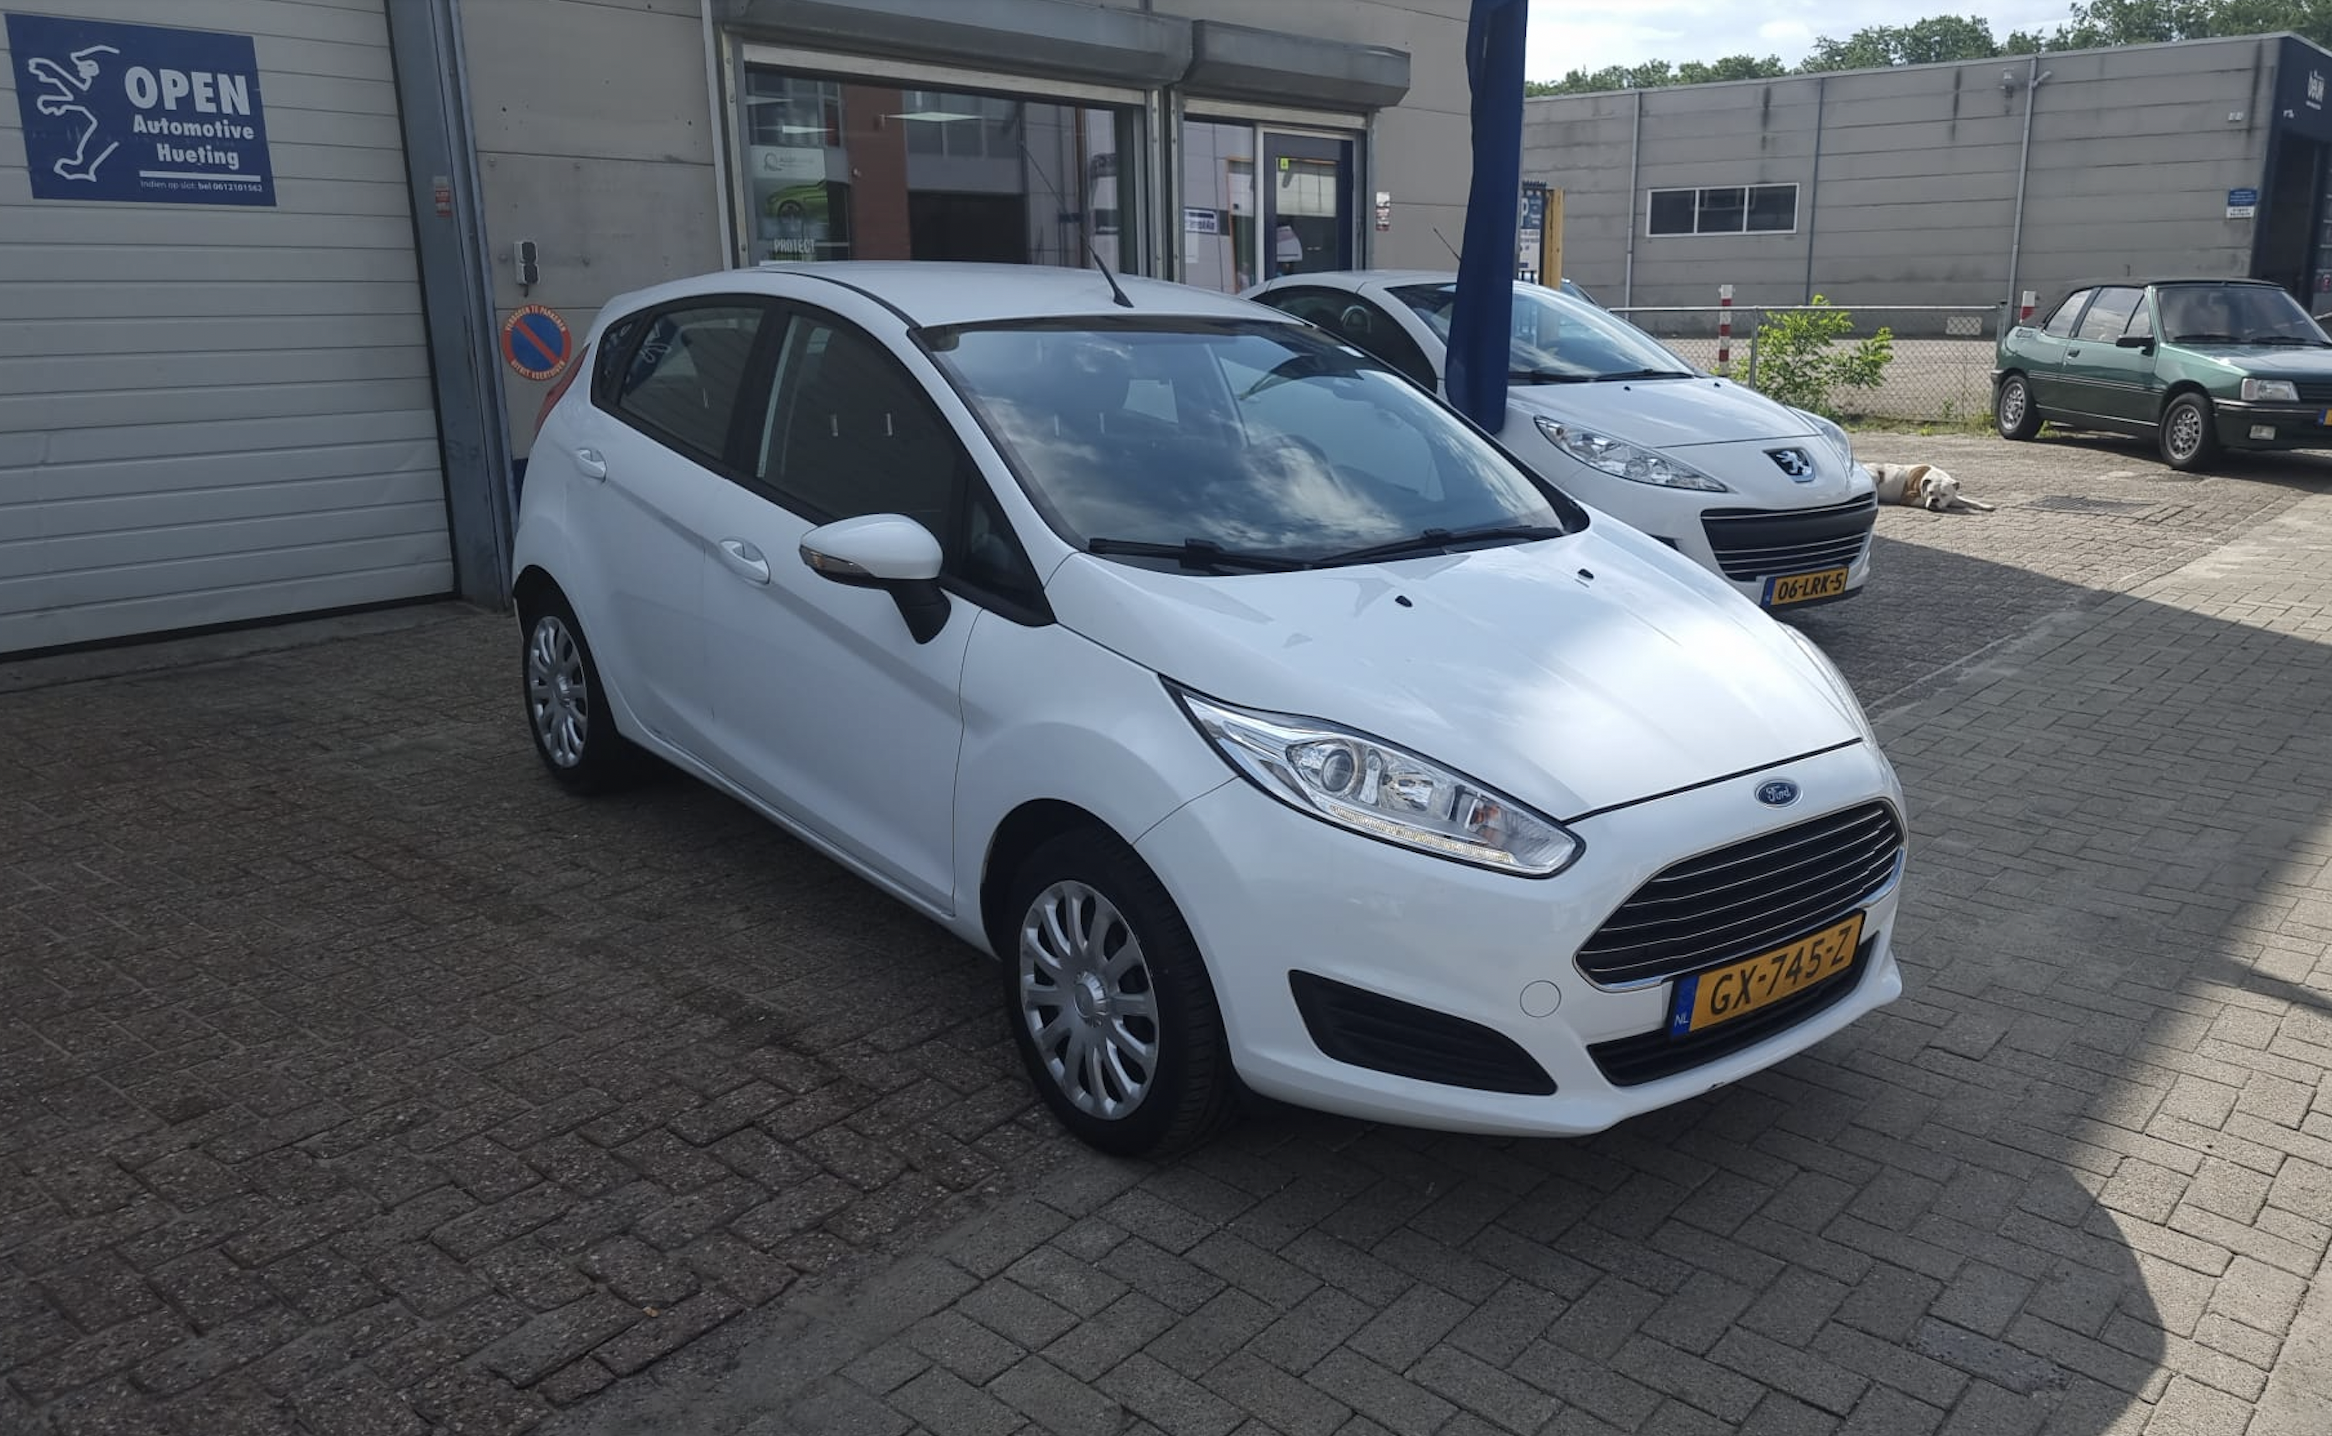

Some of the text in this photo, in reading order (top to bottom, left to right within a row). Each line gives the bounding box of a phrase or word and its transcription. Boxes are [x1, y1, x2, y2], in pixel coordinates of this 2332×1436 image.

[124, 66, 250, 115] OPEN
[133, 114, 254, 139] Automotive
[156, 143, 239, 170] Hueting
[198, 182, 211, 191] bel
[774, 238, 815, 255] PROTECT
[1778, 573, 1843, 600] 06-LRK-5
[1765, 786, 1791, 799] Ford
[1710, 926, 1852, 1015] GX-745-Z
[1674, 1013, 1690, 1027] NL
